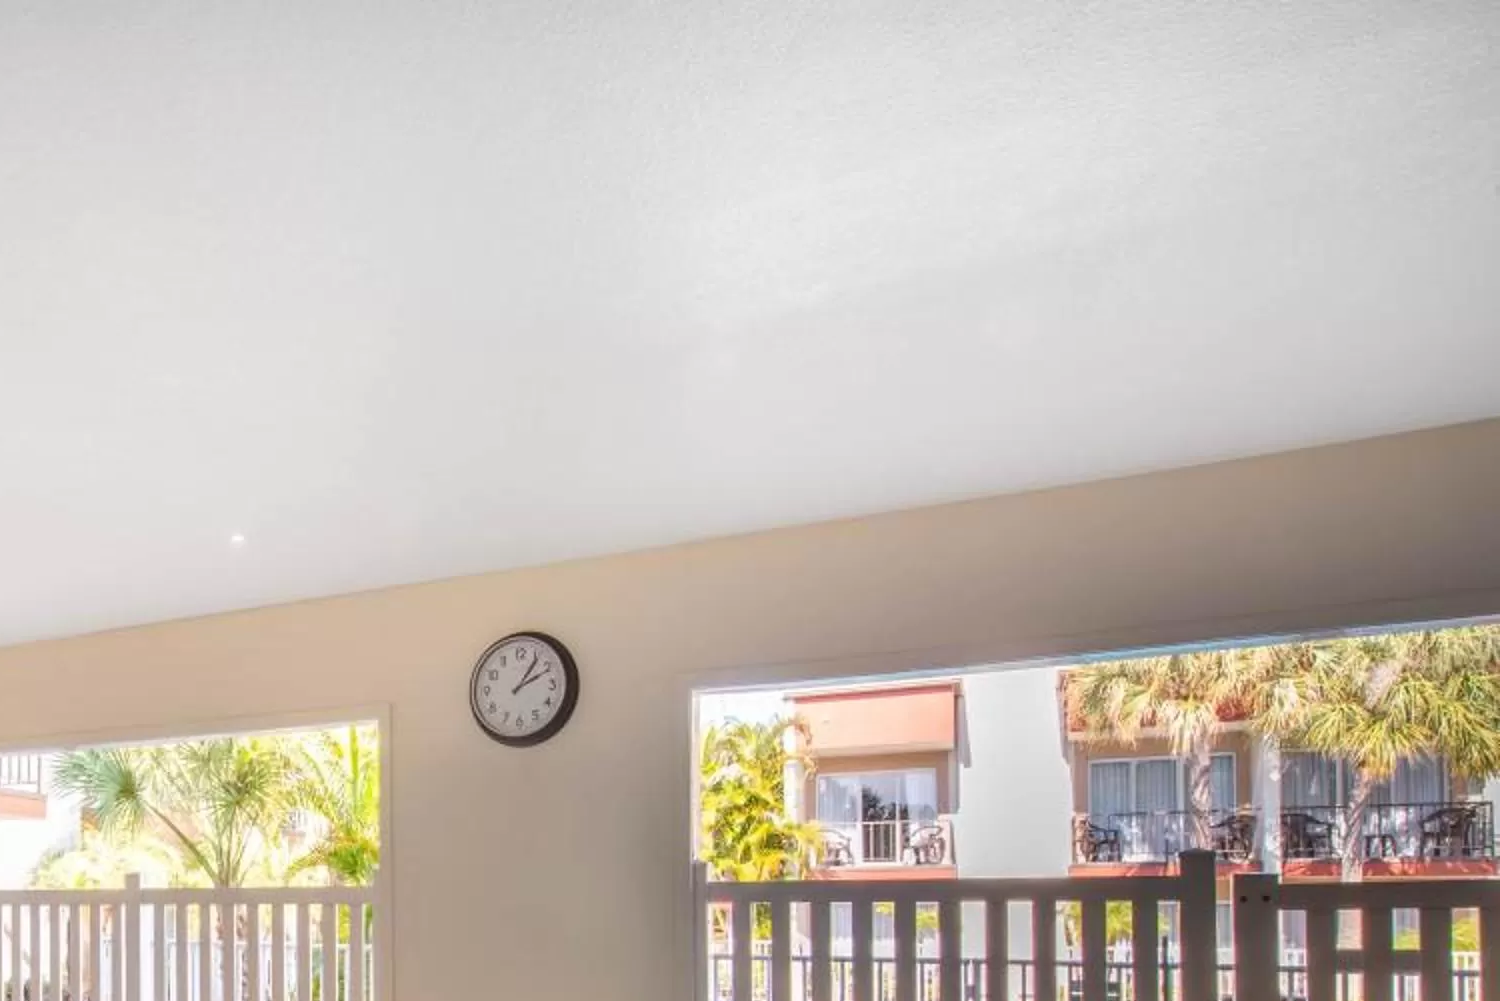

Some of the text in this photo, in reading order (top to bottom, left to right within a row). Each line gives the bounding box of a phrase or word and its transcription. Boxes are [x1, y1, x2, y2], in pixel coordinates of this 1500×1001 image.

[515, 647, 527, 661] 12
[488, 669, 499, 681] 10
[483, 685, 491, 697] 9
[548, 679, 557, 691] 3
[531, 709, 540, 721] 5
